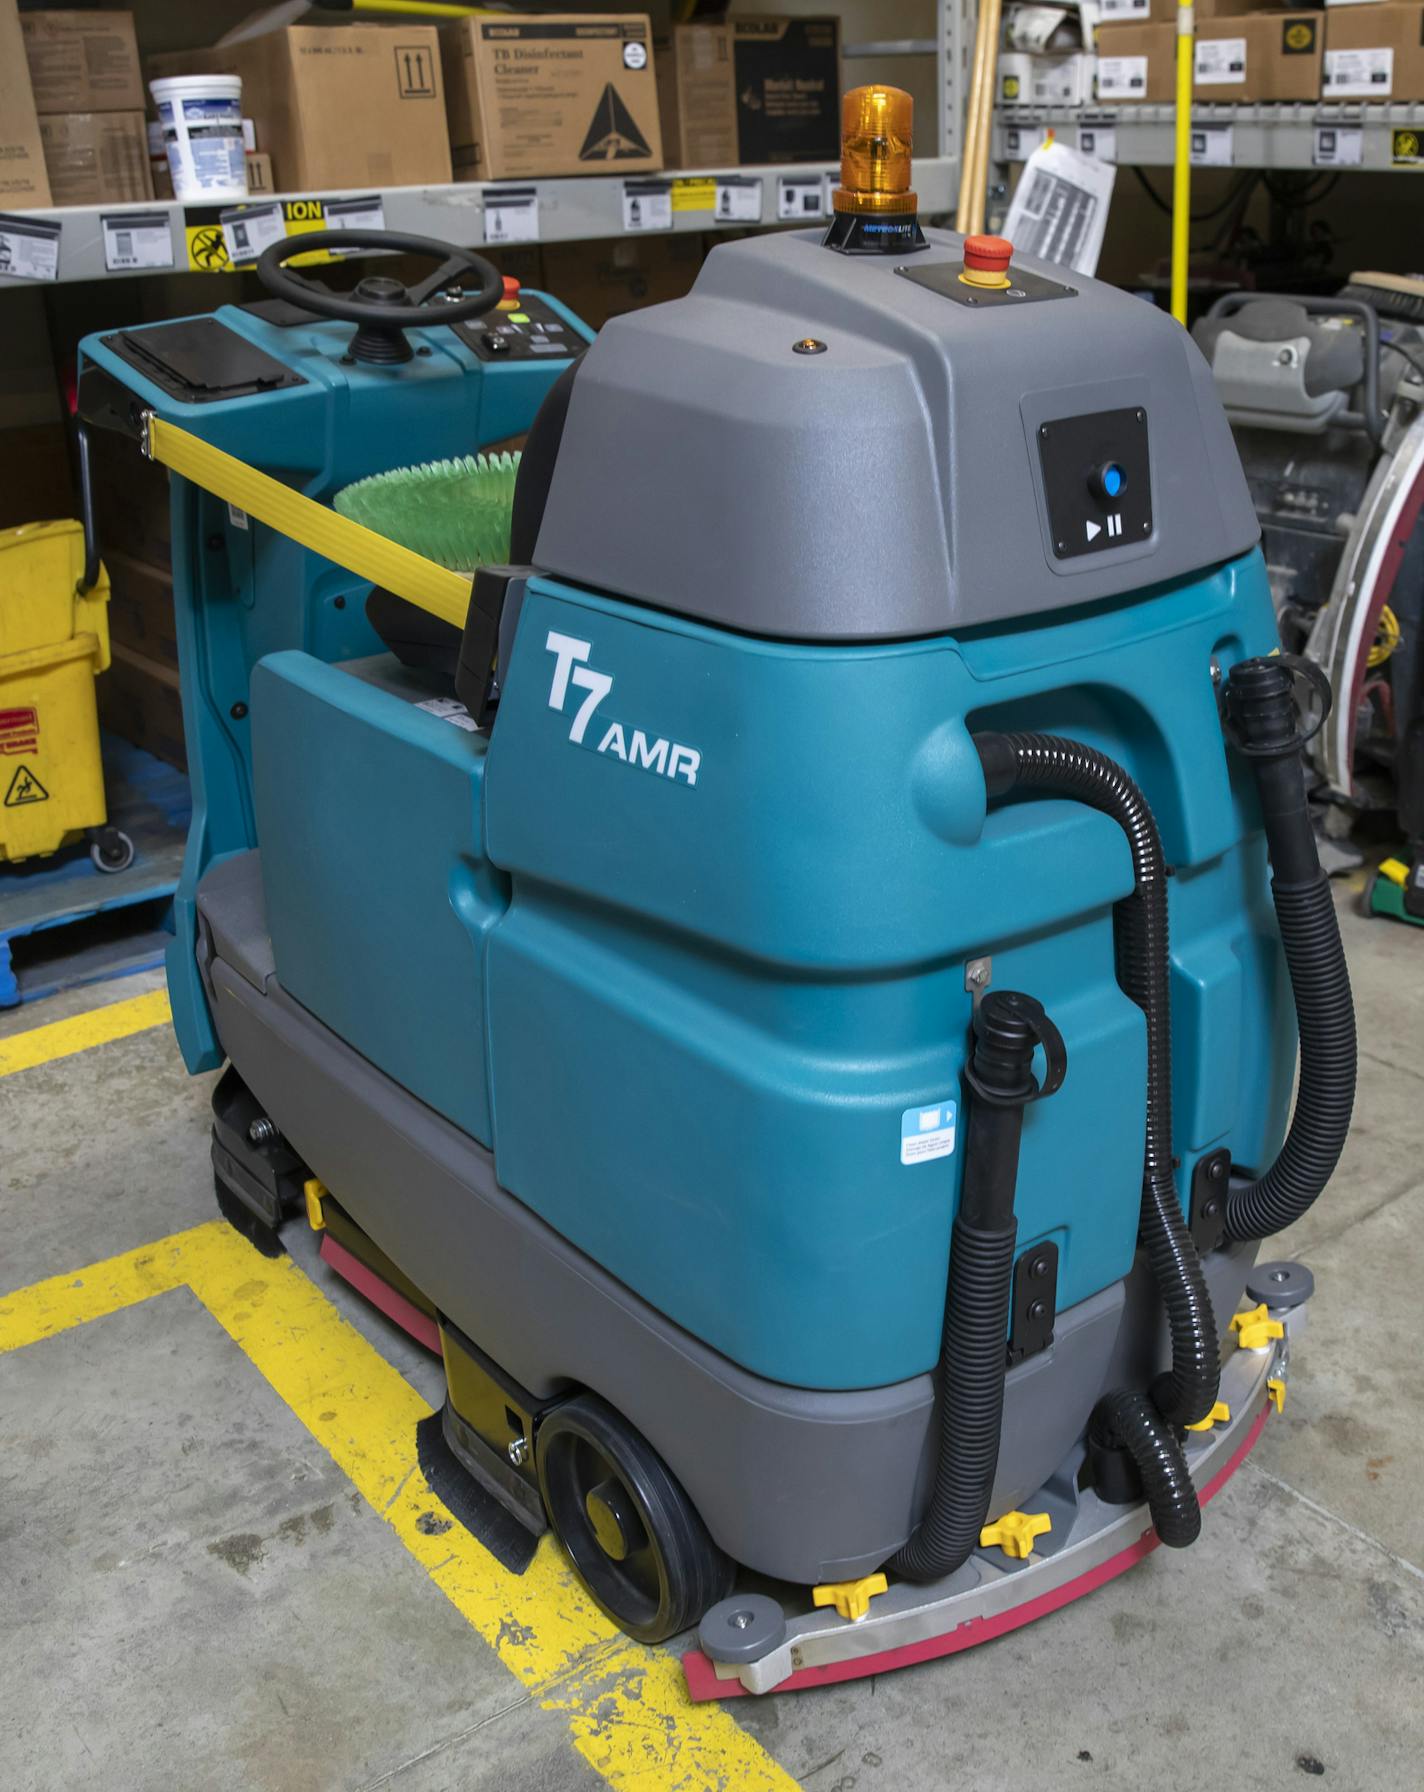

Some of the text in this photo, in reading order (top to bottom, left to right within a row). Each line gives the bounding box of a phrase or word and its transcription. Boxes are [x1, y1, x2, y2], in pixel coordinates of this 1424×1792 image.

[494, 48, 583, 59] TB Disinfectant
[494, 65, 539, 75] Cleaner
[545, 630, 700, 785] T7 AMR
